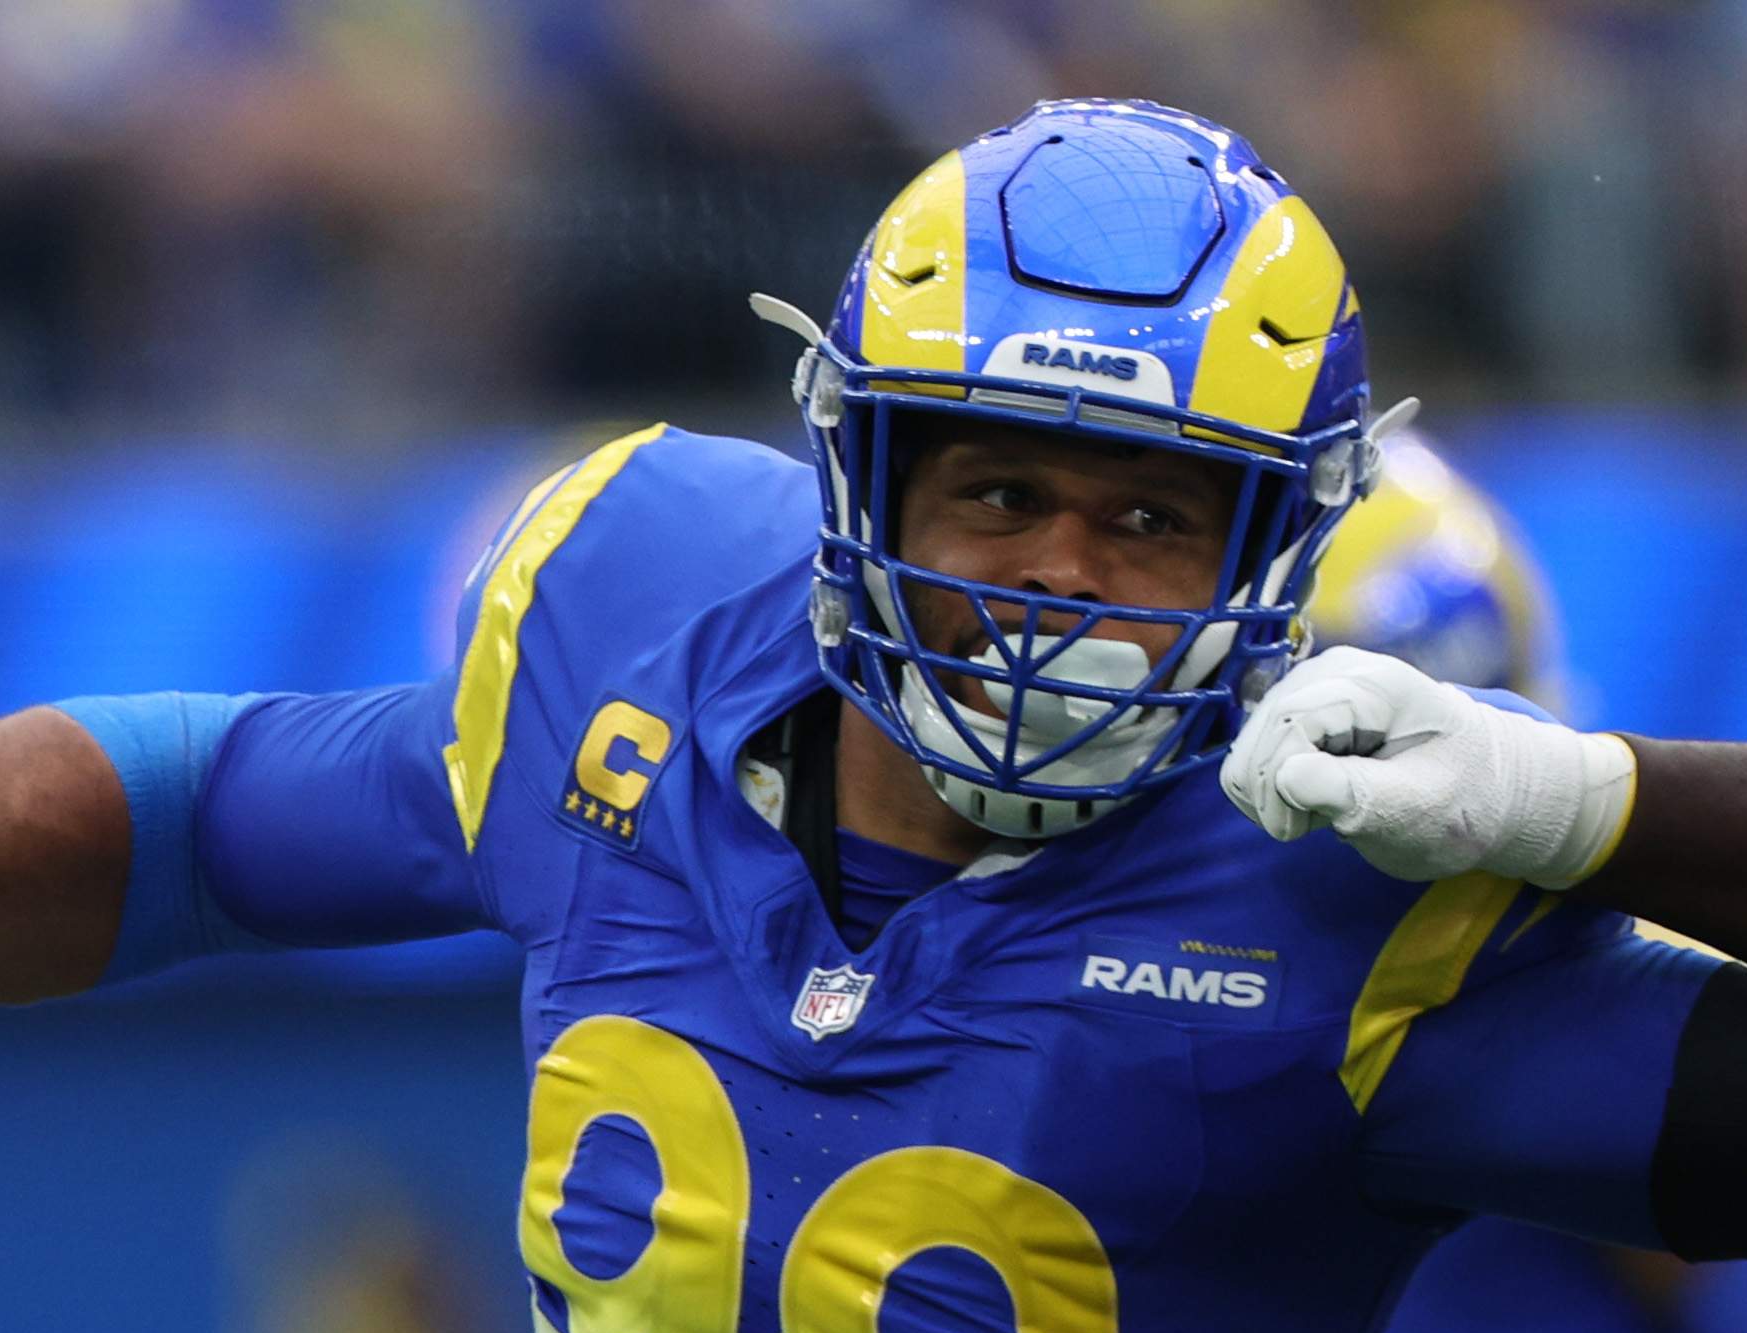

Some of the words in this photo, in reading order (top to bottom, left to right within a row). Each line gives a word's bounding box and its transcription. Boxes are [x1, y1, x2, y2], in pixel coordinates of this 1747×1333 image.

[1022, 342, 1139, 382] RAMS
[575, 699, 672, 812] C
[1080, 954, 1268, 1009] RAMS
[803, 993, 848, 1024] NFL
